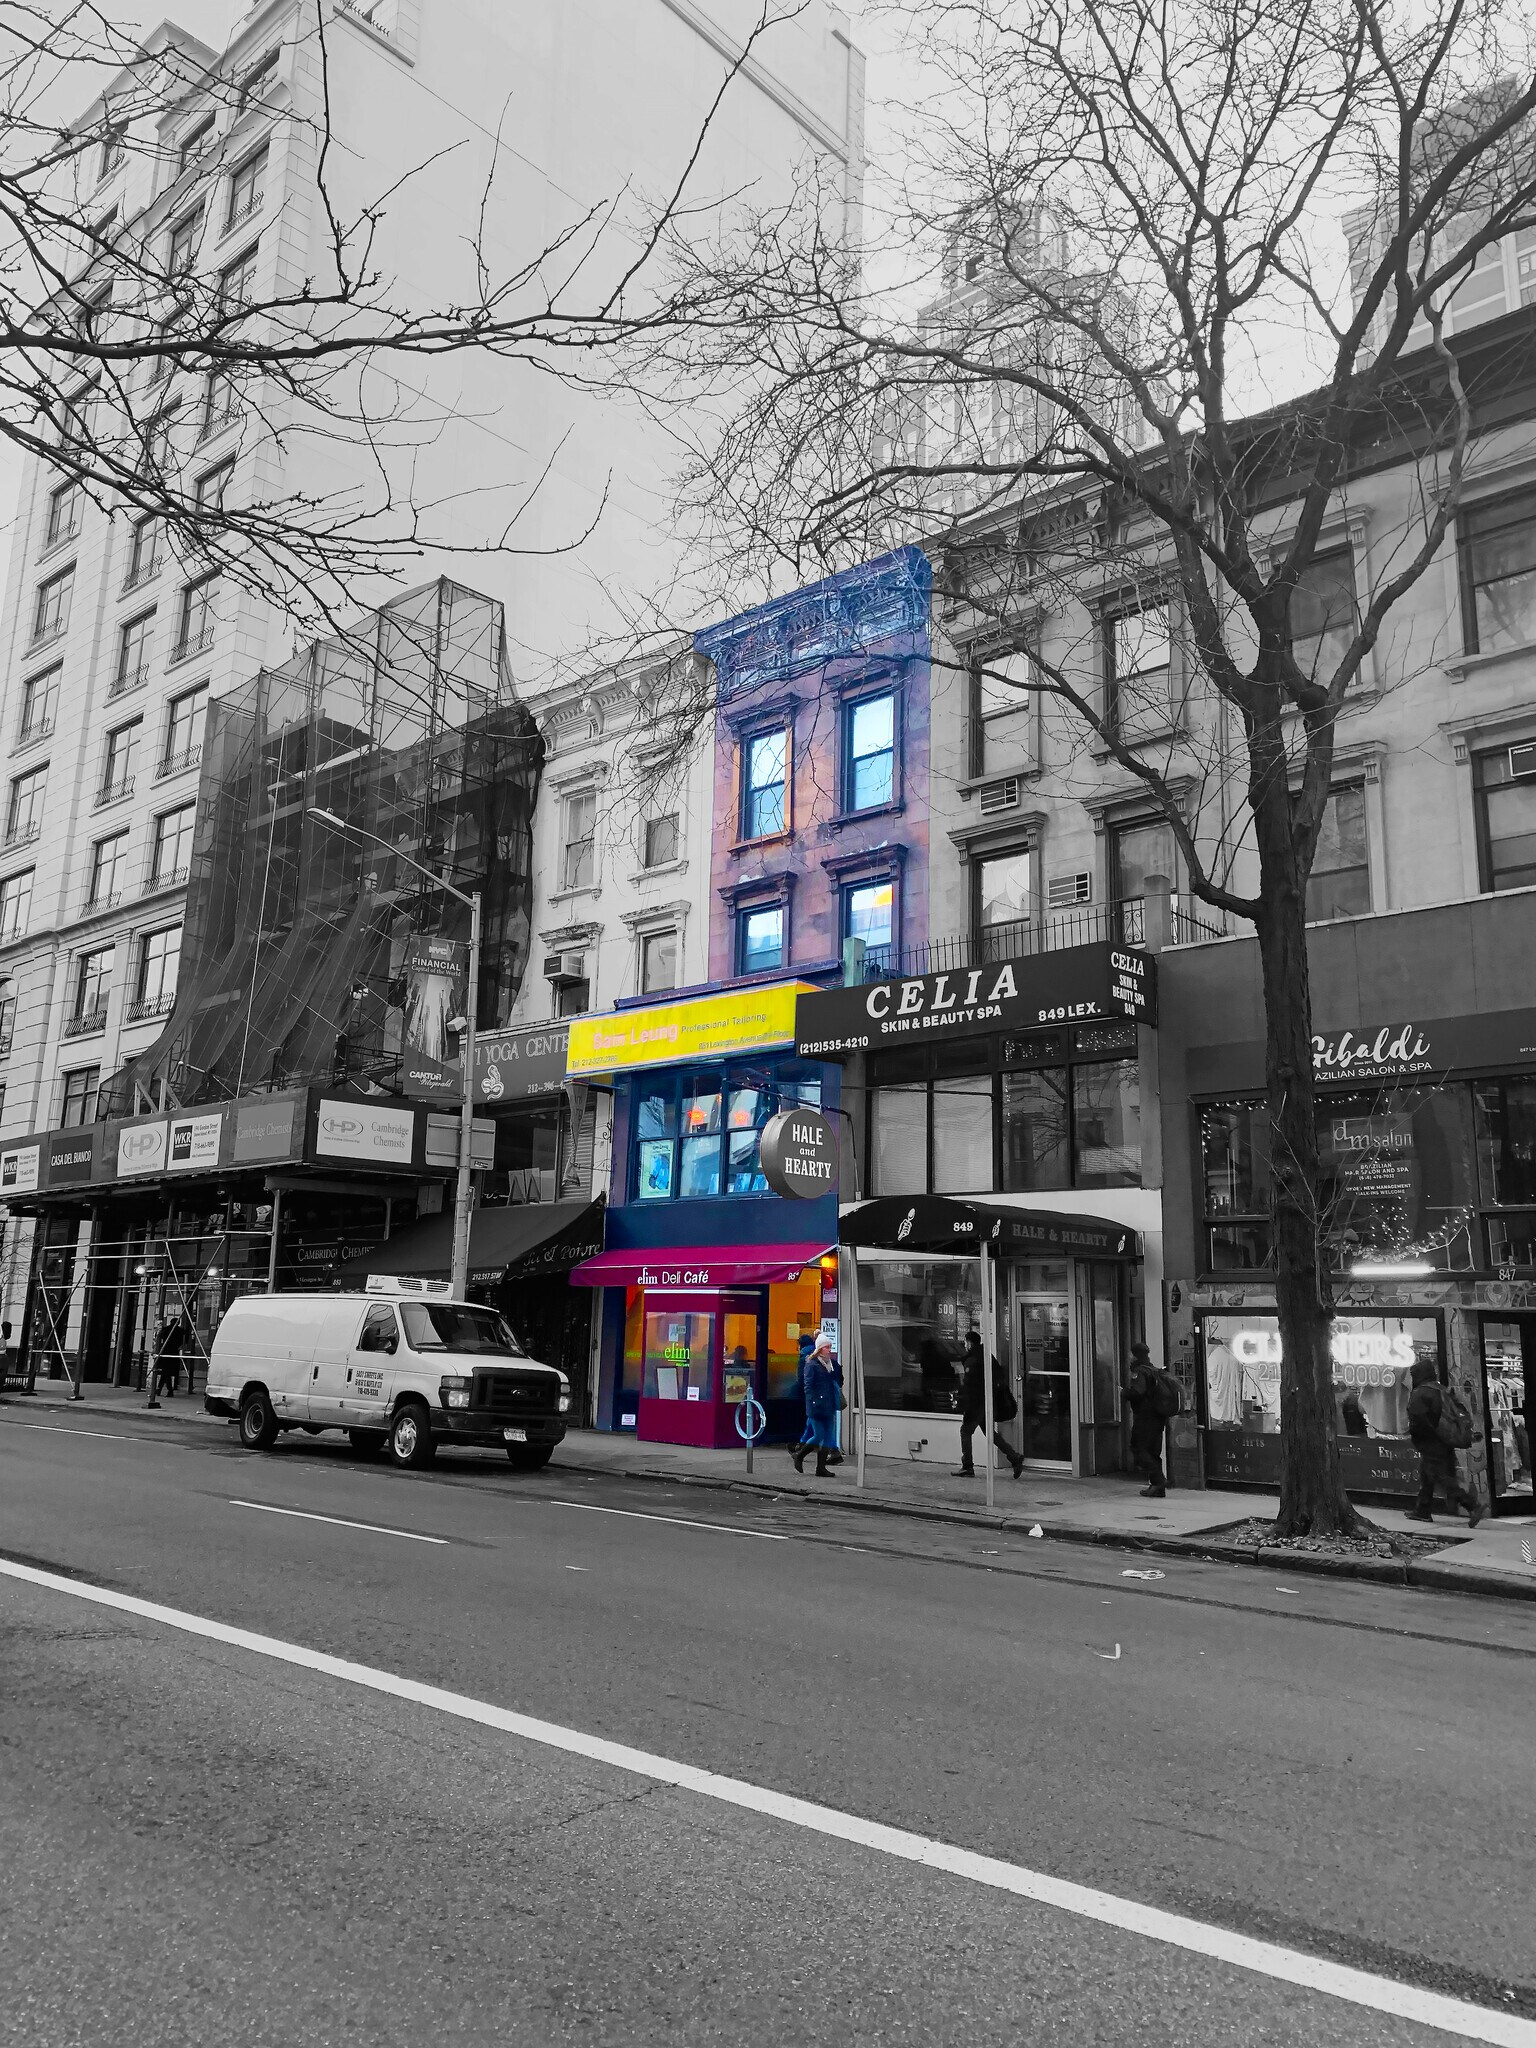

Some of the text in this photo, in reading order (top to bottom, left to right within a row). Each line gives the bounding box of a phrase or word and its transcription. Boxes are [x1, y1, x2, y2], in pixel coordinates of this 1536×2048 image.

[412, 957, 460, 972] FINANCIAL
[1111, 952, 1144, 976] CELIA
[866, 964, 1018, 1018] CELIA
[1119, 974, 1138, 991] SKIN &
[1112, 984, 1146, 1006] BEAUTY SPA
[1038, 1001, 1102, 1022] 849 LEX.
[1124, 1002, 1136, 1016] 849
[881, 1005, 1002, 1034] SKIN & BEAUTY SPA
[630, 1024, 678, 1044] Leung
[682, 1018, 730, 1032] Professional
[732, 1013, 767, 1026] Tailoring
[485, 1041, 520, 1063] YOGA
[800, 1036, 868, 1054] (212)535-4210
[409, 1070, 442, 1080] CANTOR
[1314, 1061, 1432, 1080] AZILIAN SALON & SPA
[418, 1079, 454, 1090] Fitzgerald
[236, 1123, 266, 1141] Cambridge
[266, 1122, 292, 1136] Chemists
[371, 1120, 410, 1137] Cambridge
[792, 1123, 823, 1146] HALE
[174, 1132, 192, 1145] WKR
[374, 1135, 406, 1148] Chemists
[1373, 1130, 1412, 1148] salon
[51, 1154, 64, 1166] CASA
[64, 1153, 73, 1164] DEL
[74, 1150, 92, 1164] BIANCO
[800, 1146, 816, 1157] and
[784, 1156, 832, 1179] HEARTY
[954, 1221, 974, 1232] 849
[1012, 1223, 1108, 1247] HALE & HEARTY
[298, 1248, 338, 1262] CAMBRIDG
[638, 1267, 708, 1284] elim Deli Café
[1498, 1268, 1516, 1280] 847
[938, 1304, 954, 1315] 500
[664, 1342, 690, 1360] elim
